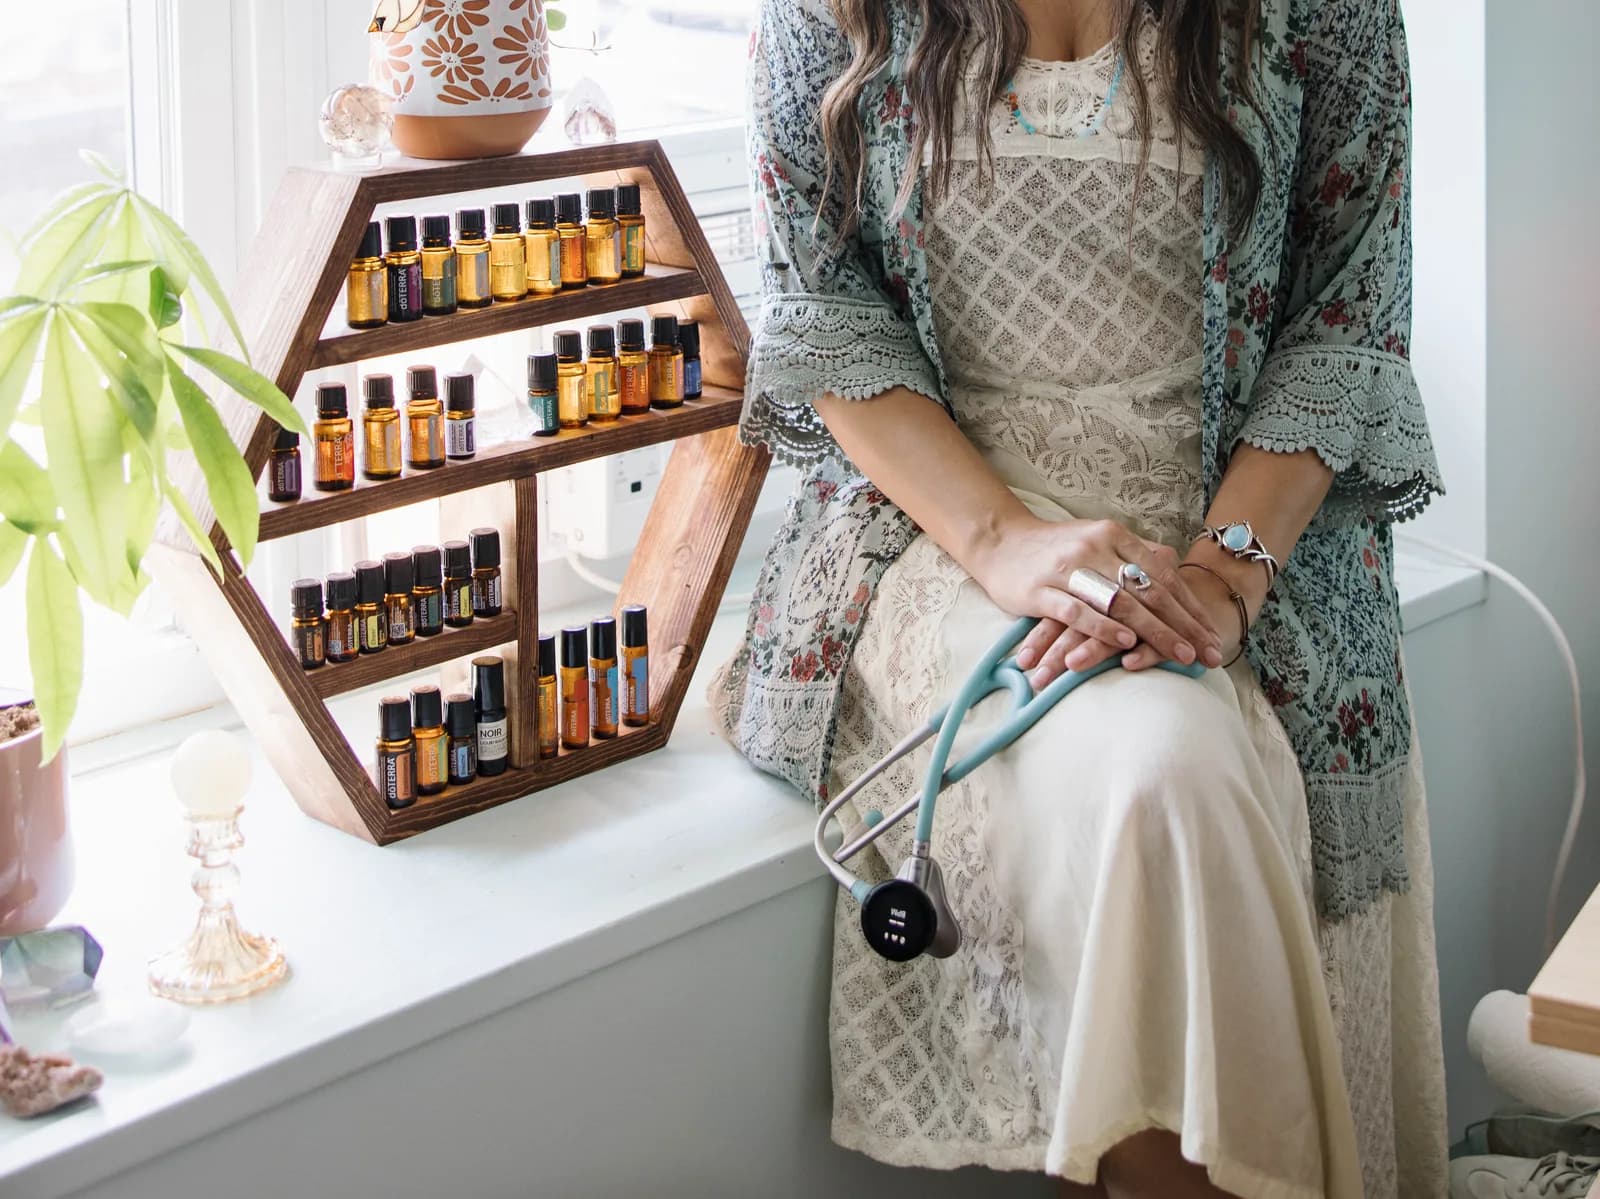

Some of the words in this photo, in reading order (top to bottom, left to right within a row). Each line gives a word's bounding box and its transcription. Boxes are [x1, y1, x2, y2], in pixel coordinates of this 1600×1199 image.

[335, 436, 343, 479] dTERRA
[480, 727, 502, 738] NOIR
[387, 757, 396, 799] dōTERRA
